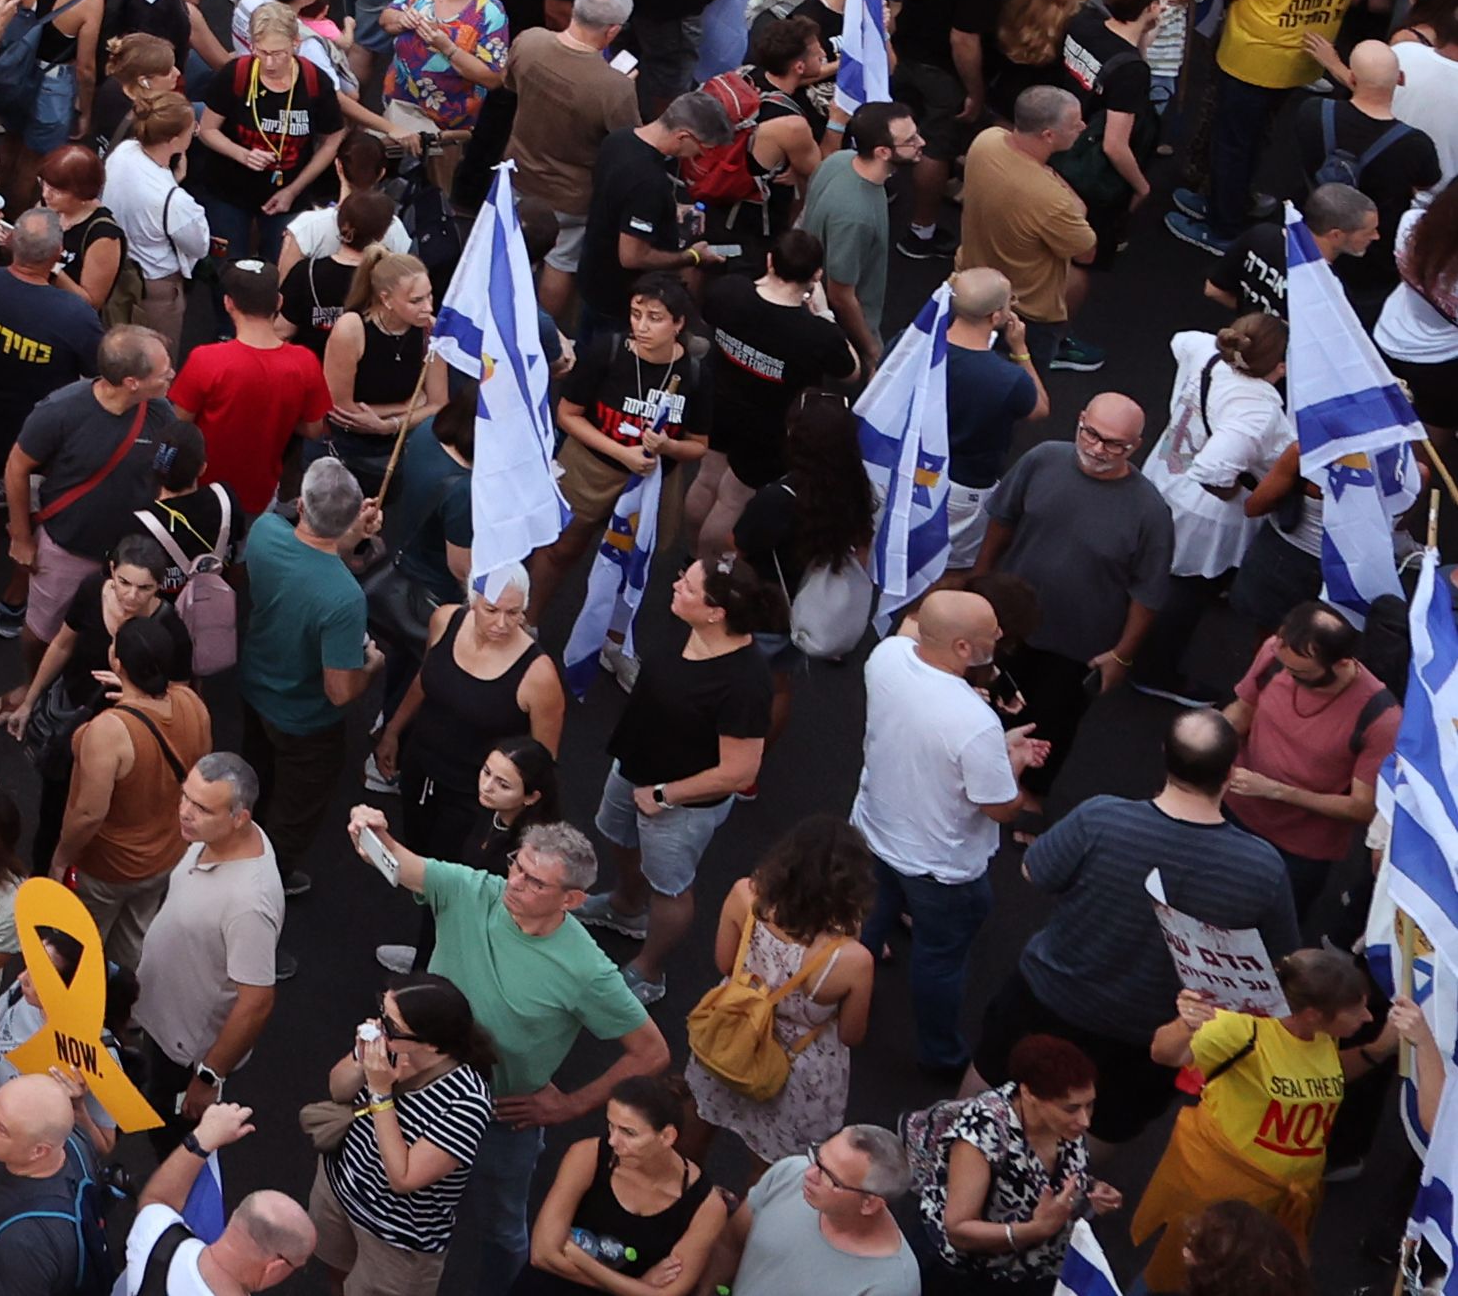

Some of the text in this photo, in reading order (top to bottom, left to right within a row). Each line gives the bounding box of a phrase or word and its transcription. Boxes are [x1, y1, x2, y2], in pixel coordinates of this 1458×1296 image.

[54, 1030, 103, 1079] NOW.
[1271, 1075, 1331, 1100] SEAL THE
